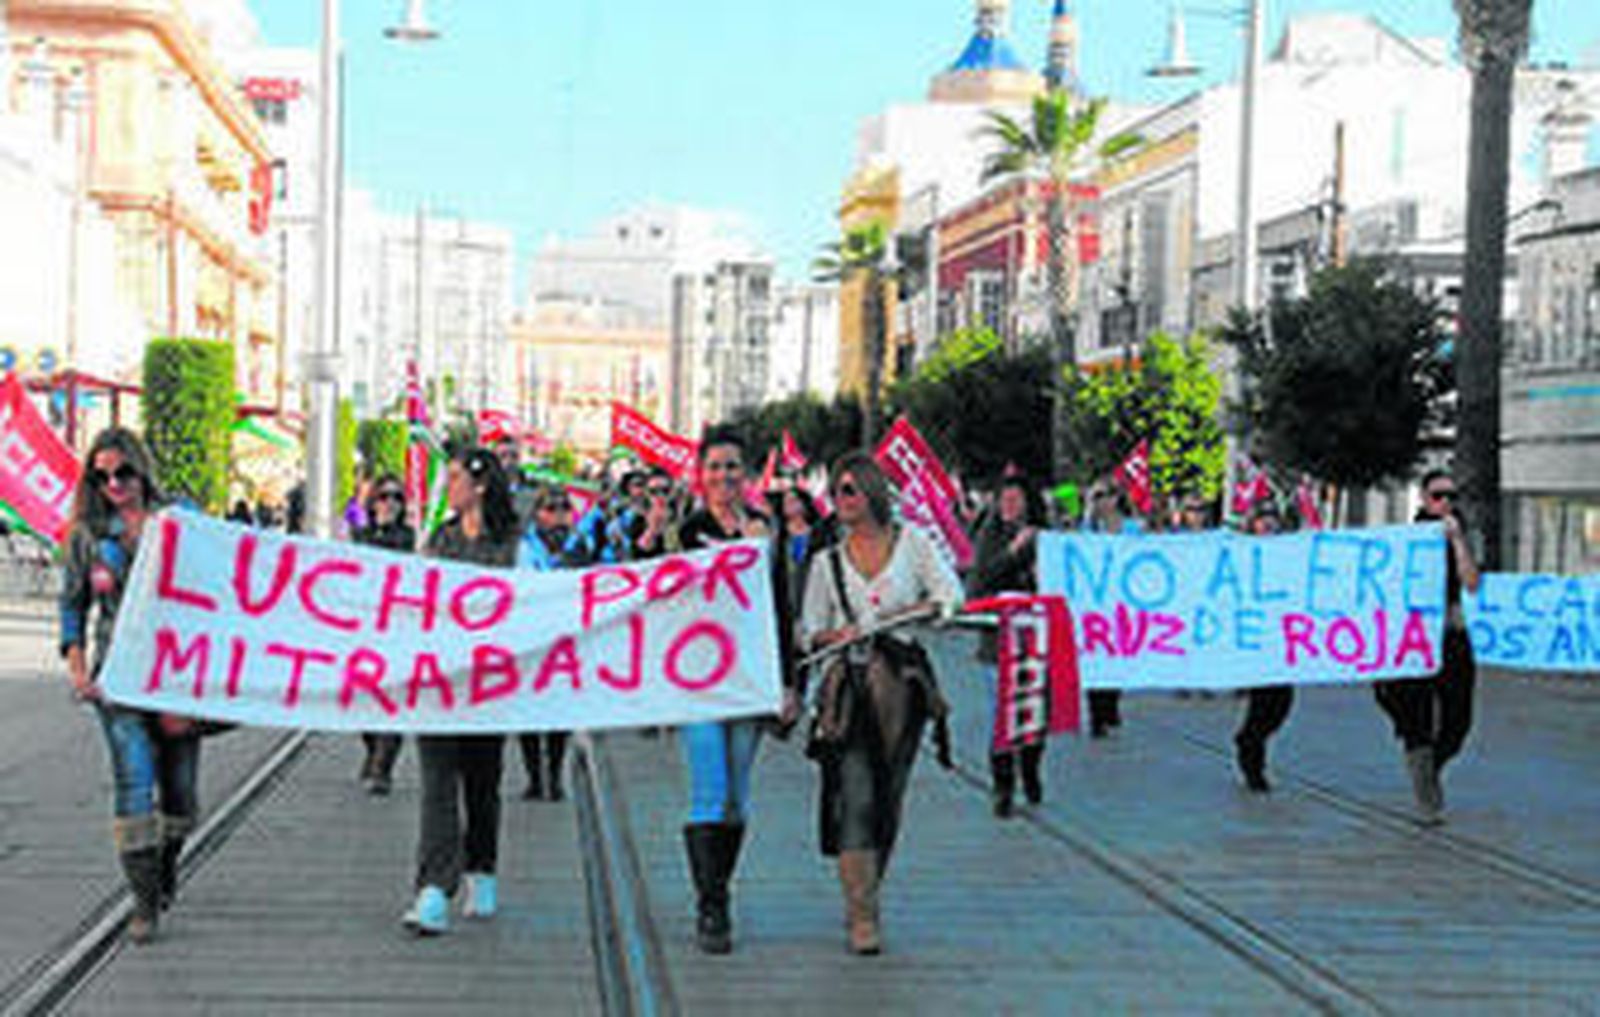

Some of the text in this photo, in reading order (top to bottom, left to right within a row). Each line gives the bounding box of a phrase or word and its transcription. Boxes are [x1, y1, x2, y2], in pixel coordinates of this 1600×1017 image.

[156, 517, 760, 633] LUCHO POR
[1064, 542, 1177, 610] NO
[1206, 546, 1289, 602] AL
[1081, 603, 1437, 673] RUZ DE ROJA
